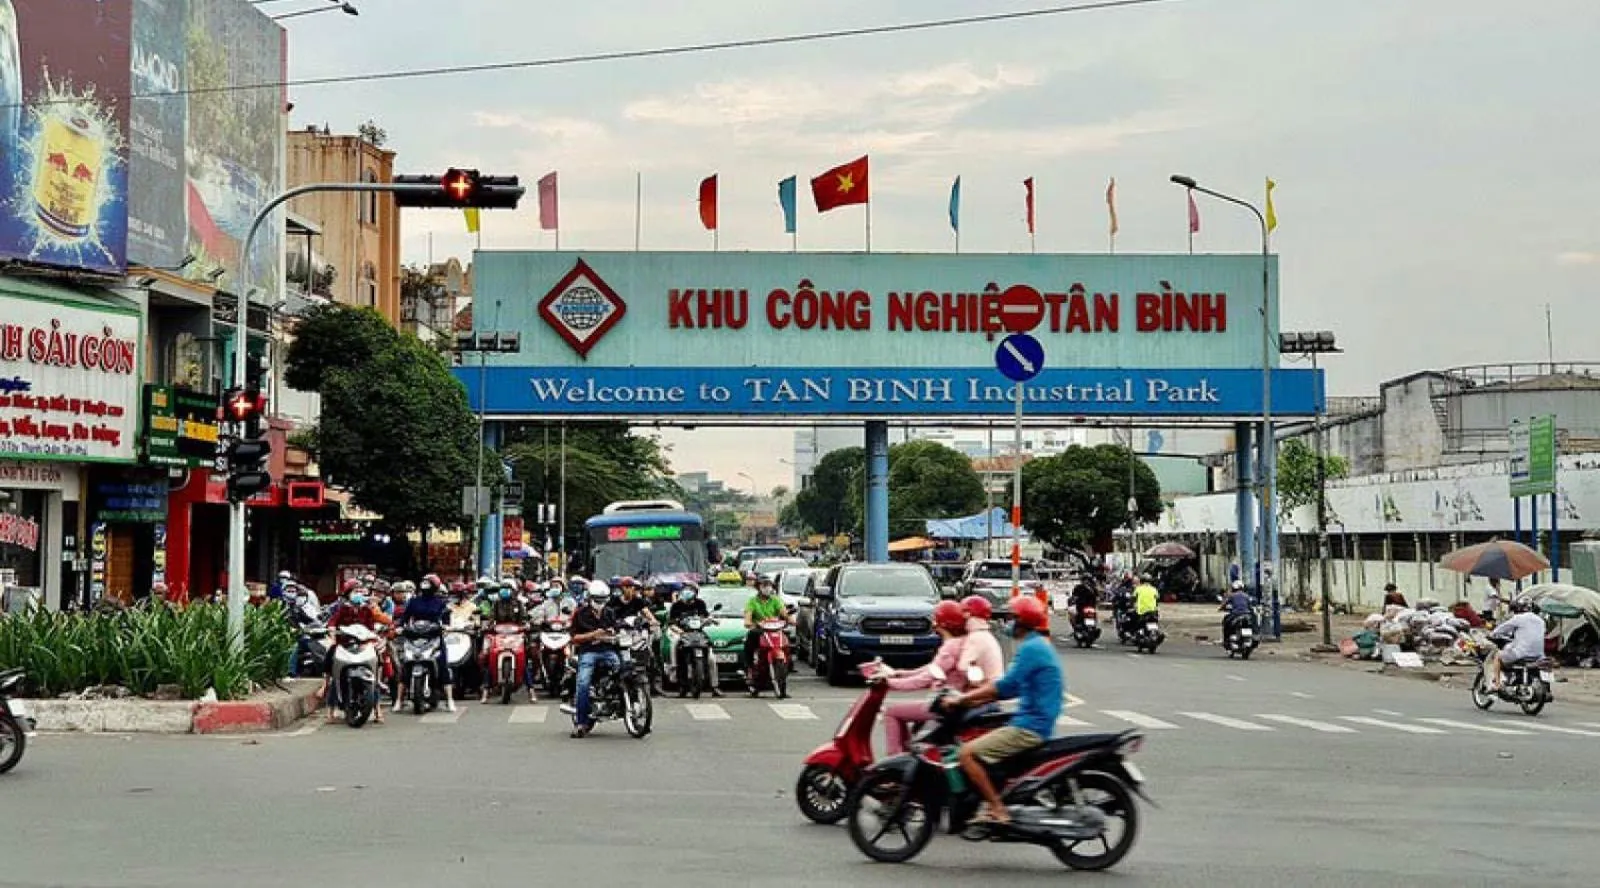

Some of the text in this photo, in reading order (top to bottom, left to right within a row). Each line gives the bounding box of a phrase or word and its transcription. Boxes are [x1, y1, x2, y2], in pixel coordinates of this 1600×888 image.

[668, 278, 1227, 341] KHU CÔNG NGHIỆ TÂN BÌNH
[530, 377, 685, 402] Welcome
[699, 383, 731, 402] to
[743, 377, 833, 402] TAN
[847, 378, 953, 402] BINH
[1145, 378, 1221, 402] Park
